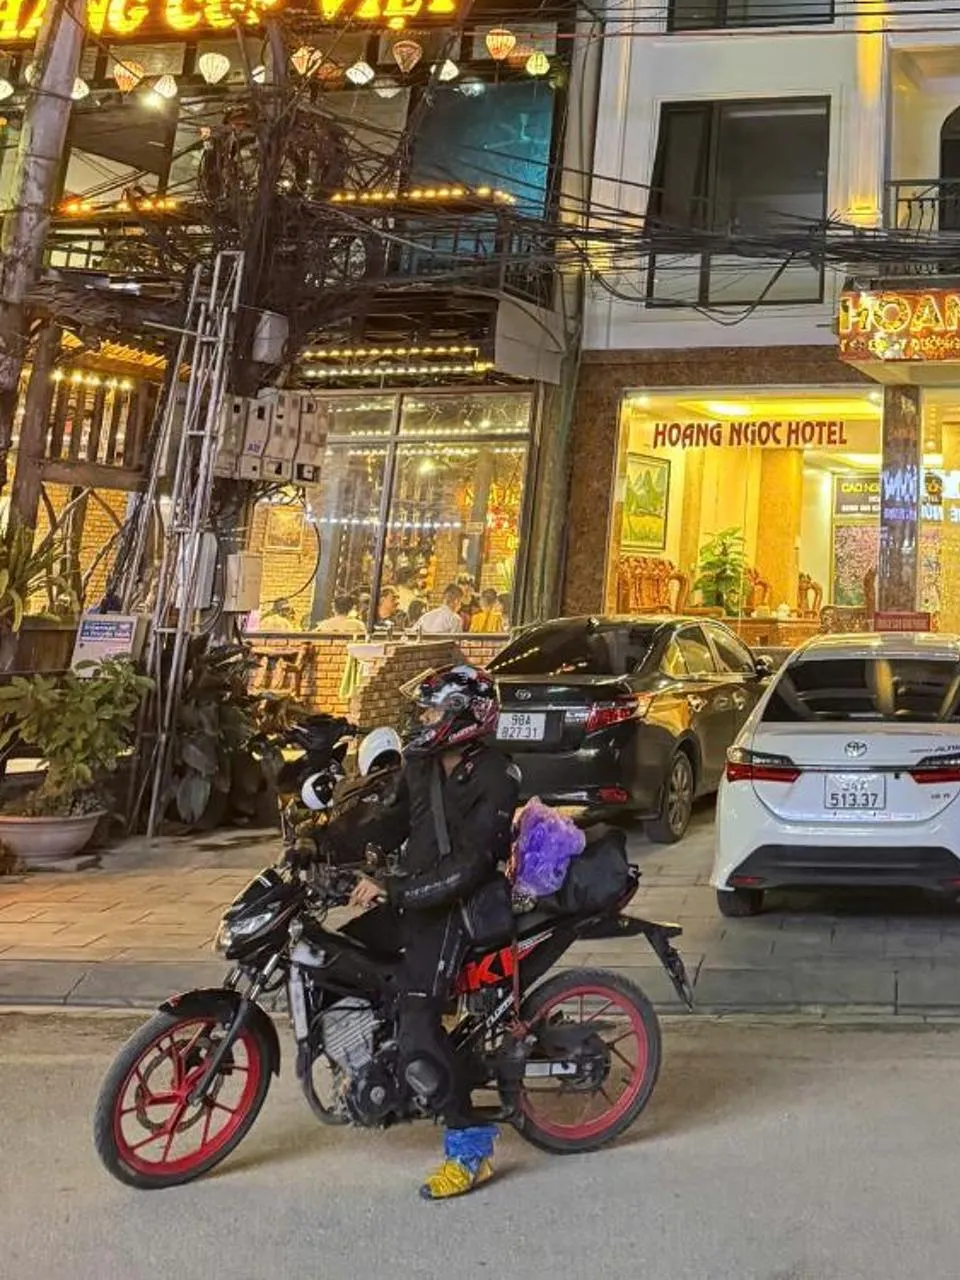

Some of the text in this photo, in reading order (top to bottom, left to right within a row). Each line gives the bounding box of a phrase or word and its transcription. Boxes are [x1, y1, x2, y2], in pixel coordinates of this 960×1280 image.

[653, 420, 847, 448] HOANG NGOC HOTEL
[830, 792, 879, 807] 513.37
